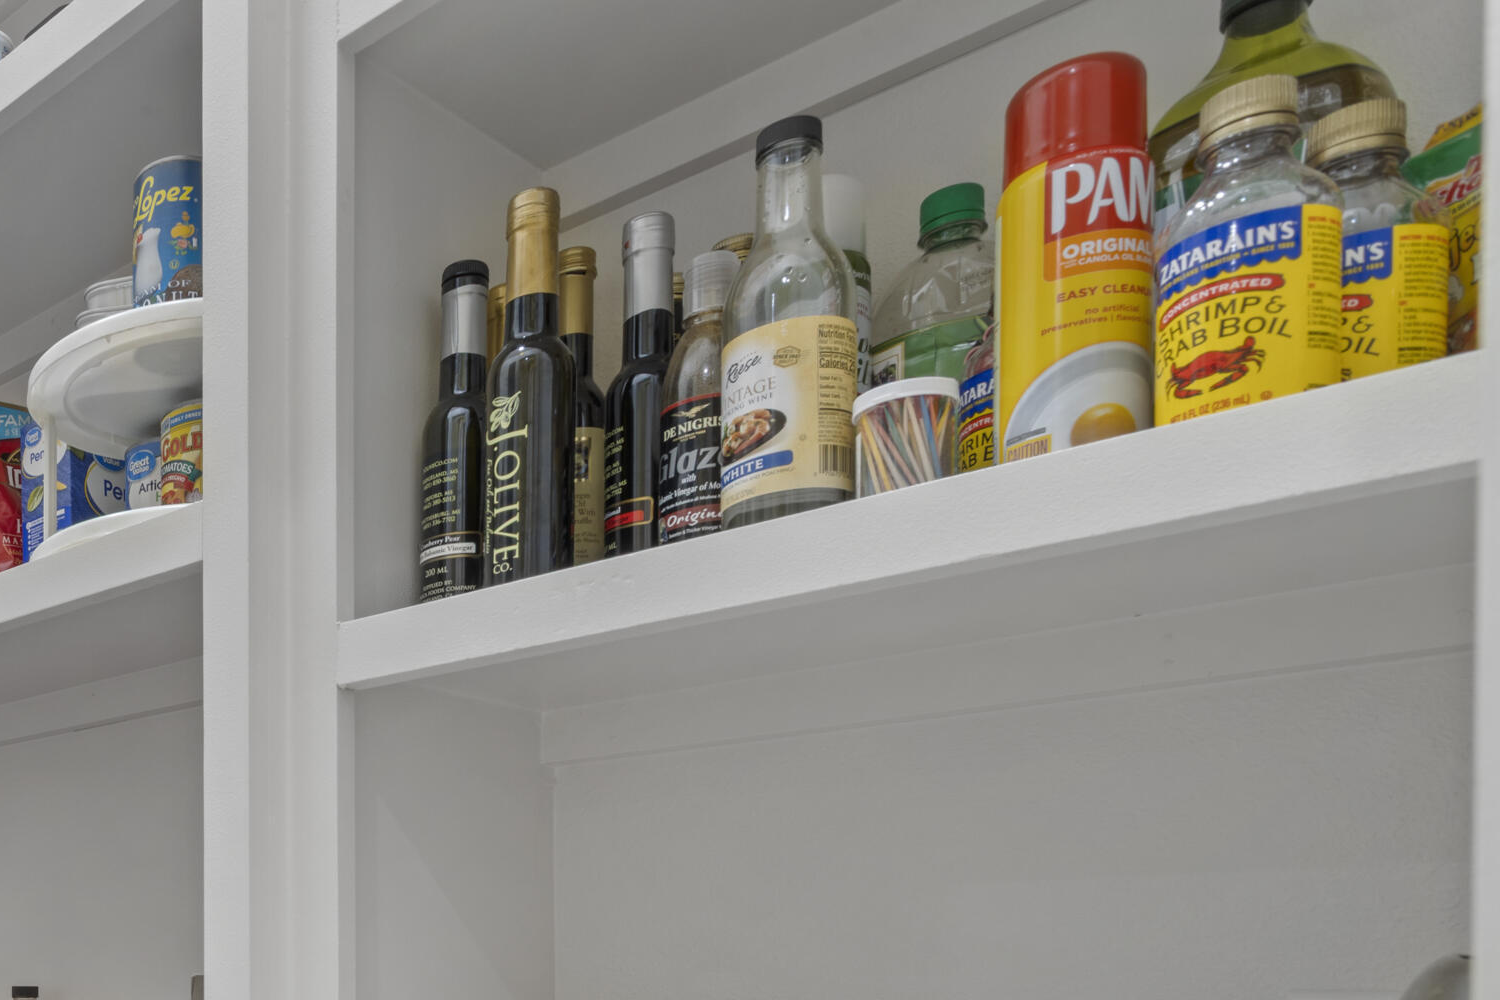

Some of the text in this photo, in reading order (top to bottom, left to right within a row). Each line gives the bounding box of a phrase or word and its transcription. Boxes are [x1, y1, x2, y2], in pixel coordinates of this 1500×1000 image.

[133, 176, 194, 230] López
[1051, 156, 1154, 236] PAM
[1062, 237, 1152, 259] ORIGINAL
[1160, 220, 1296, 286] ZATARAIN'S
[1200, 252, 1241, 271] TRADITION
[1251, 244, 1275, 255] SINCE
[1078, 254, 1120, 266] CANOLA
[1056, 283, 1152, 303] EASY CLEANU
[1162, 276, 1274, 325] CONCENTRATED
[1085, 303, 1140, 316] no artificial
[1040, 315, 1109, 337] preservatives
[1159, 295, 1287, 351] SHRIMP &
[1352, 315, 1375, 334] &
[818, 329, 846, 341] Nutrition
[1155, 316, 1293, 379] CRAB BOIL
[819, 357, 848, 370] Calories
[724, 376, 778, 409] INTAGE
[1199, 402, 1210, 414] OZ
[663, 426, 677, 442] DE
[1008, 439, 1048, 463] CAUTION
[129, 455, 150, 472] Great
[723, 457, 765, 485] WHITE
[674, 485, 698, 500] Vinegar
[699, 482, 708, 492] of
[667, 506, 722, 527] Origin
